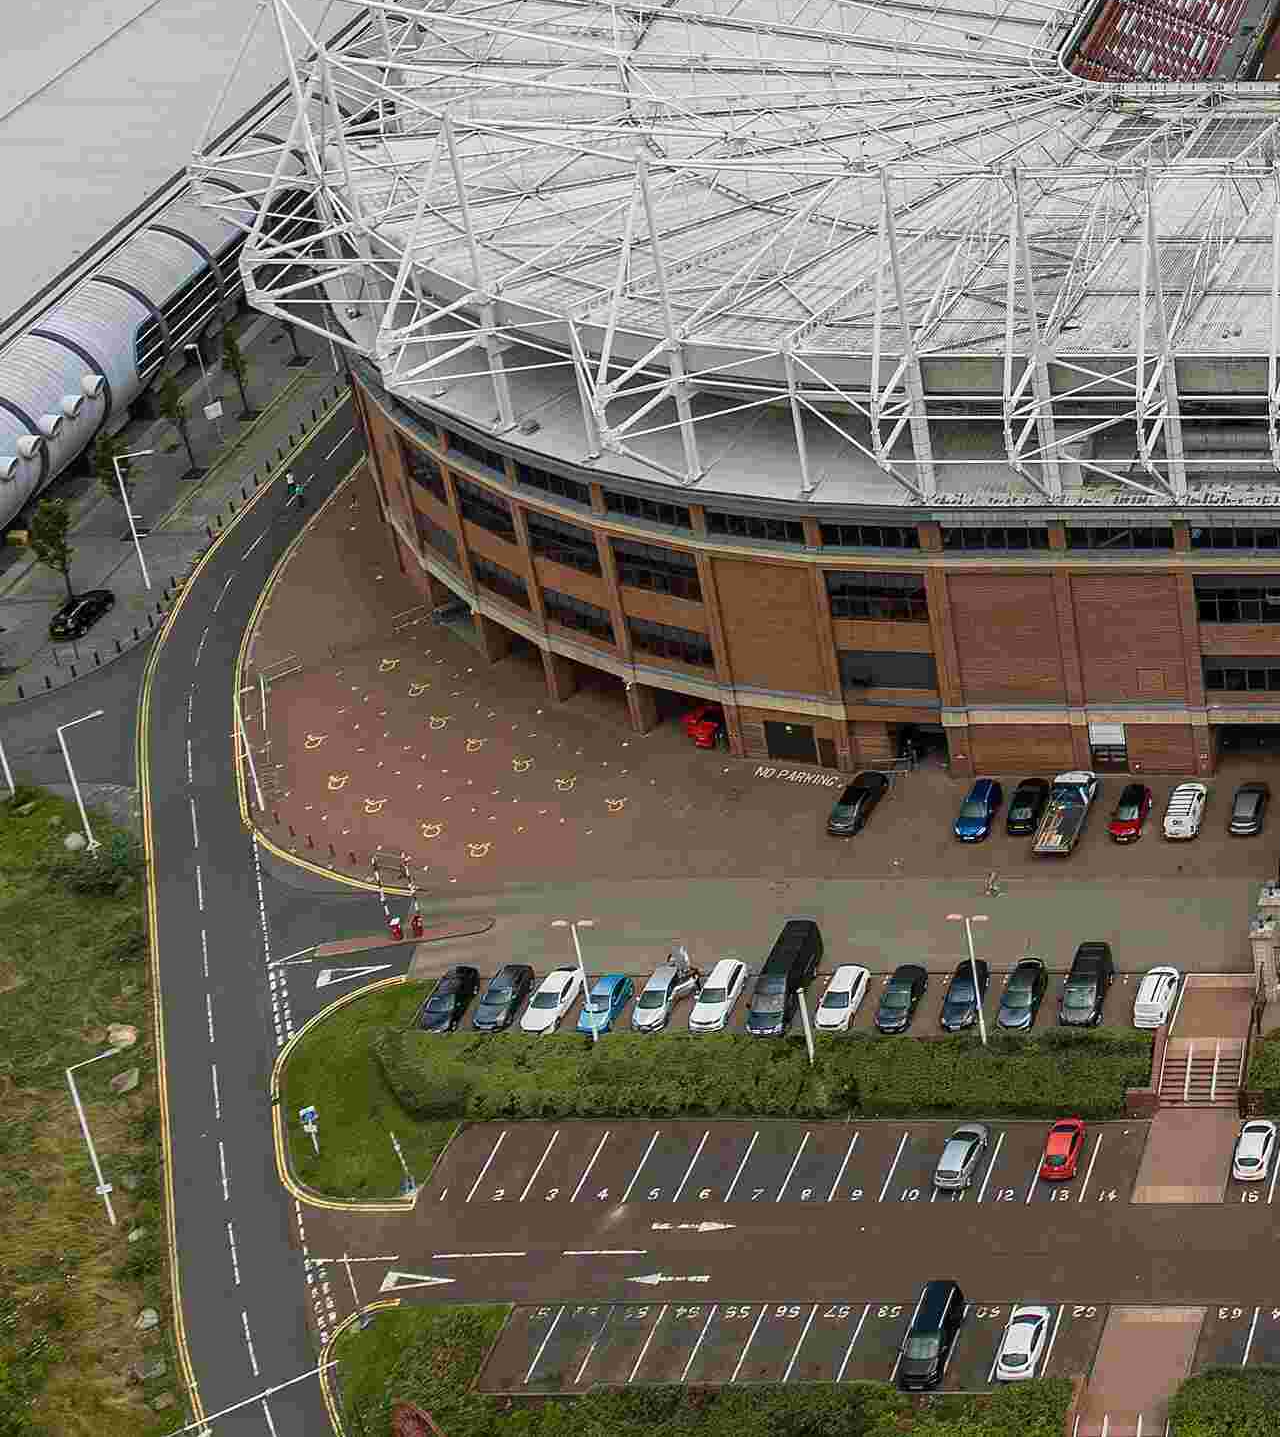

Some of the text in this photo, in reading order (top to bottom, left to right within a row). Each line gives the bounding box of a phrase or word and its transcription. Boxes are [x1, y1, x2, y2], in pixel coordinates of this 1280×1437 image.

[753, 766, 838, 787] NO PARKING
[494, 1189, 505, 1201] 2
[545, 1188, 560, 1201] 3
[597, 1188, 609, 1200] 4
[699, 1188, 711, 1200] 6
[752, 1189, 764, 1200] 7
[801, 1189, 815, 1200] 8
[851, 1189, 862, 1200] 9
[900, 1189, 920, 1200] 10
[996, 1189, 1014, 1201] 12
[1051, 1190, 1069, 1200] 13
[1098, 1191, 1120, 1201] 14
[1241, 1191, 1259, 1202] 15
[726, 1306, 751, 1317] 55
[776, 1306, 800, 1317] 56
[824, 1306, 850, 1318] 57
[1218, 1308, 1242, 1319] 63
